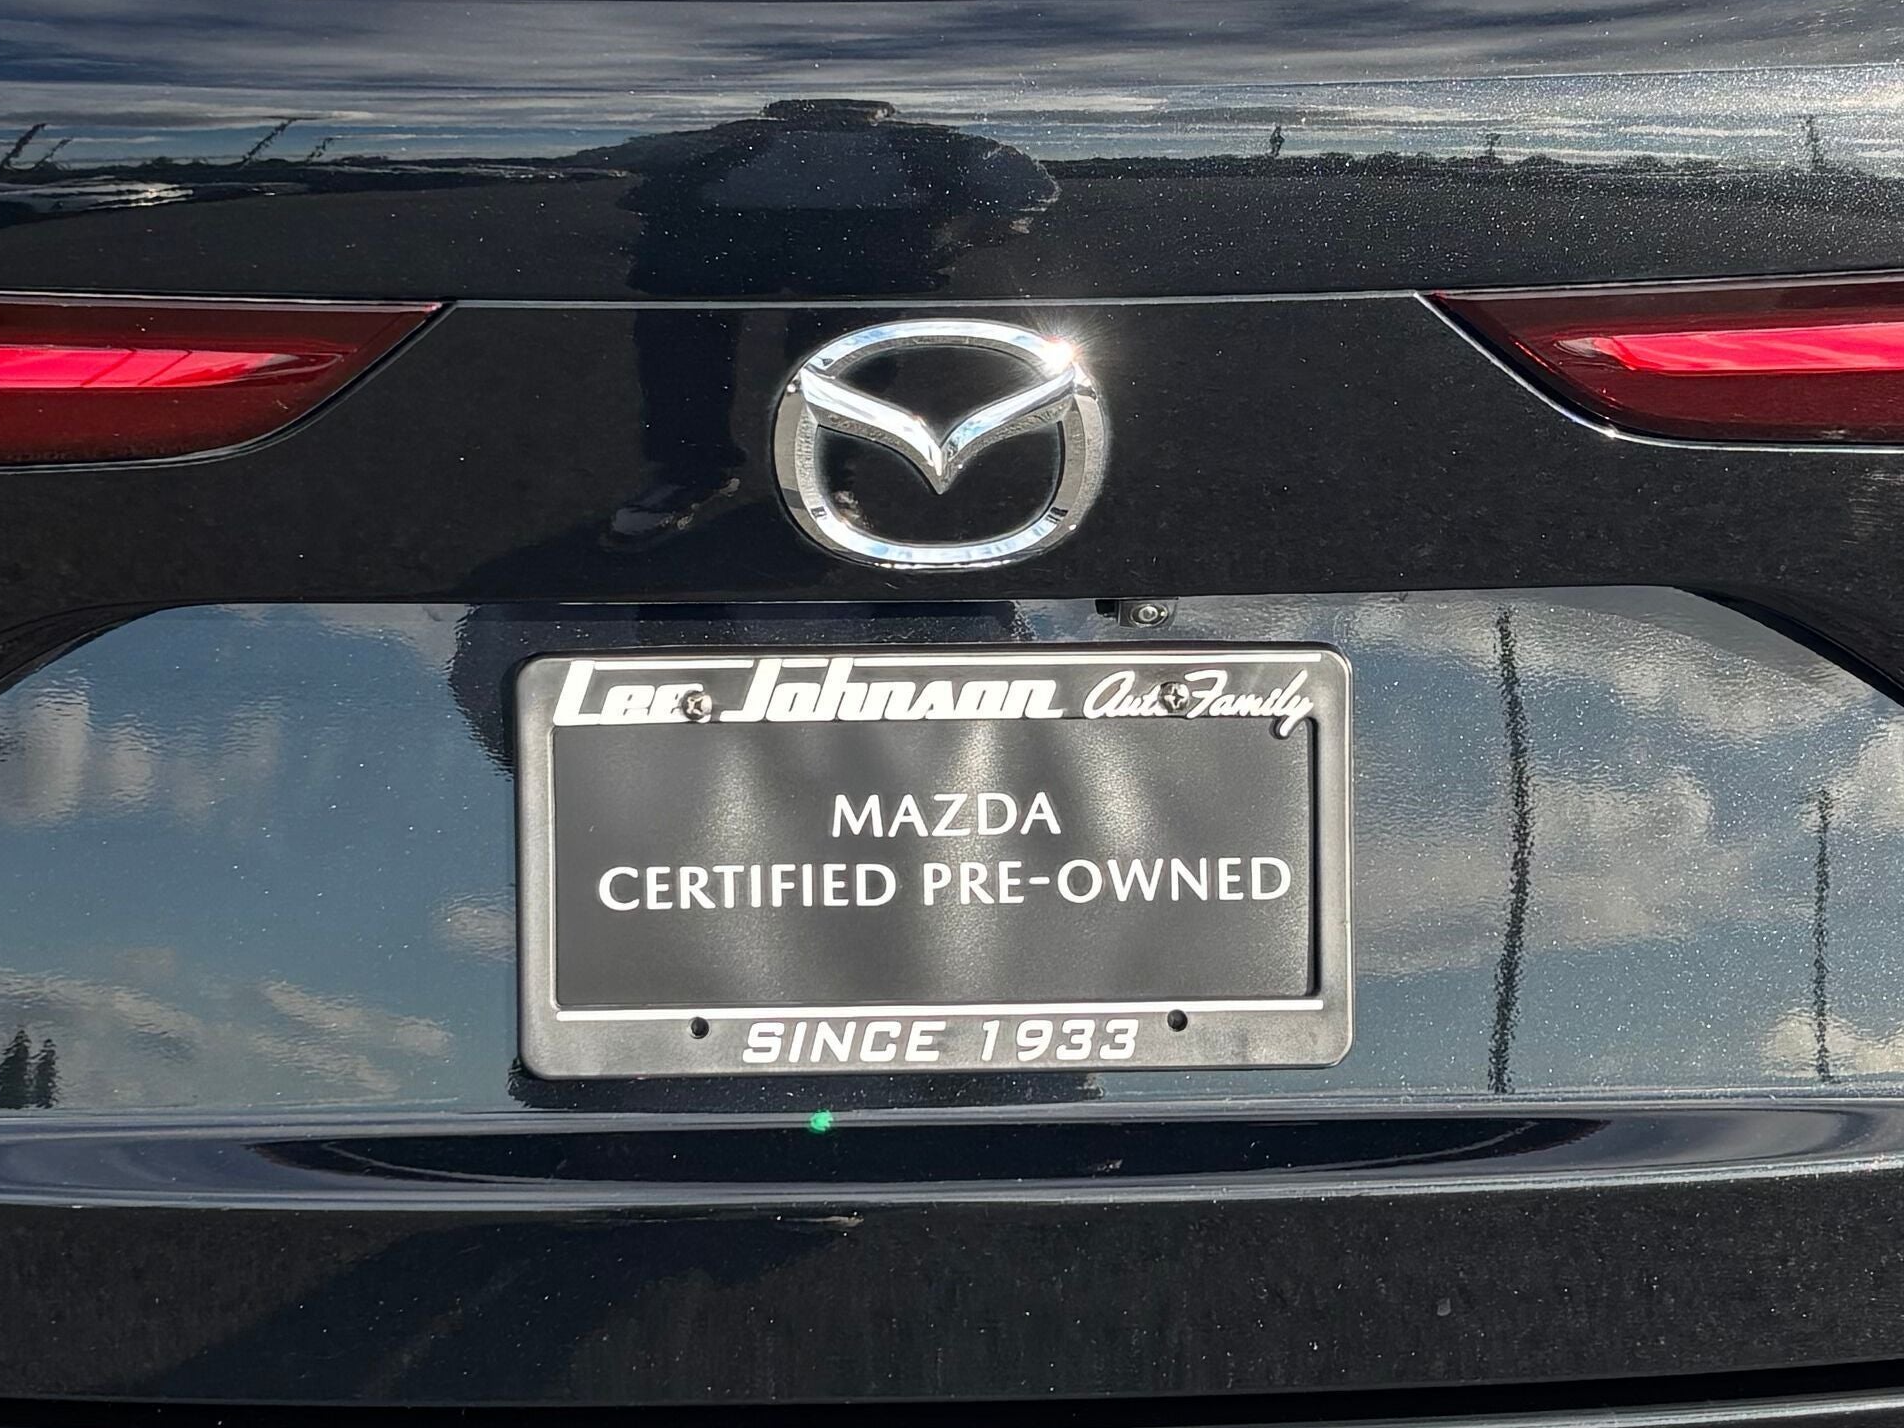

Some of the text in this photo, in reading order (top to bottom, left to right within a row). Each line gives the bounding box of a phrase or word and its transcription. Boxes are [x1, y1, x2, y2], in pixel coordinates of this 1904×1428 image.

[553, 658, 1315, 737] Lee Johnson Aut Family
[832, 792, 1063, 839] MAZDA
[598, 856, 1293, 912] CERTIFIED PRE-OWNED
[741, 1017, 1141, 1065] SINCE 1933
